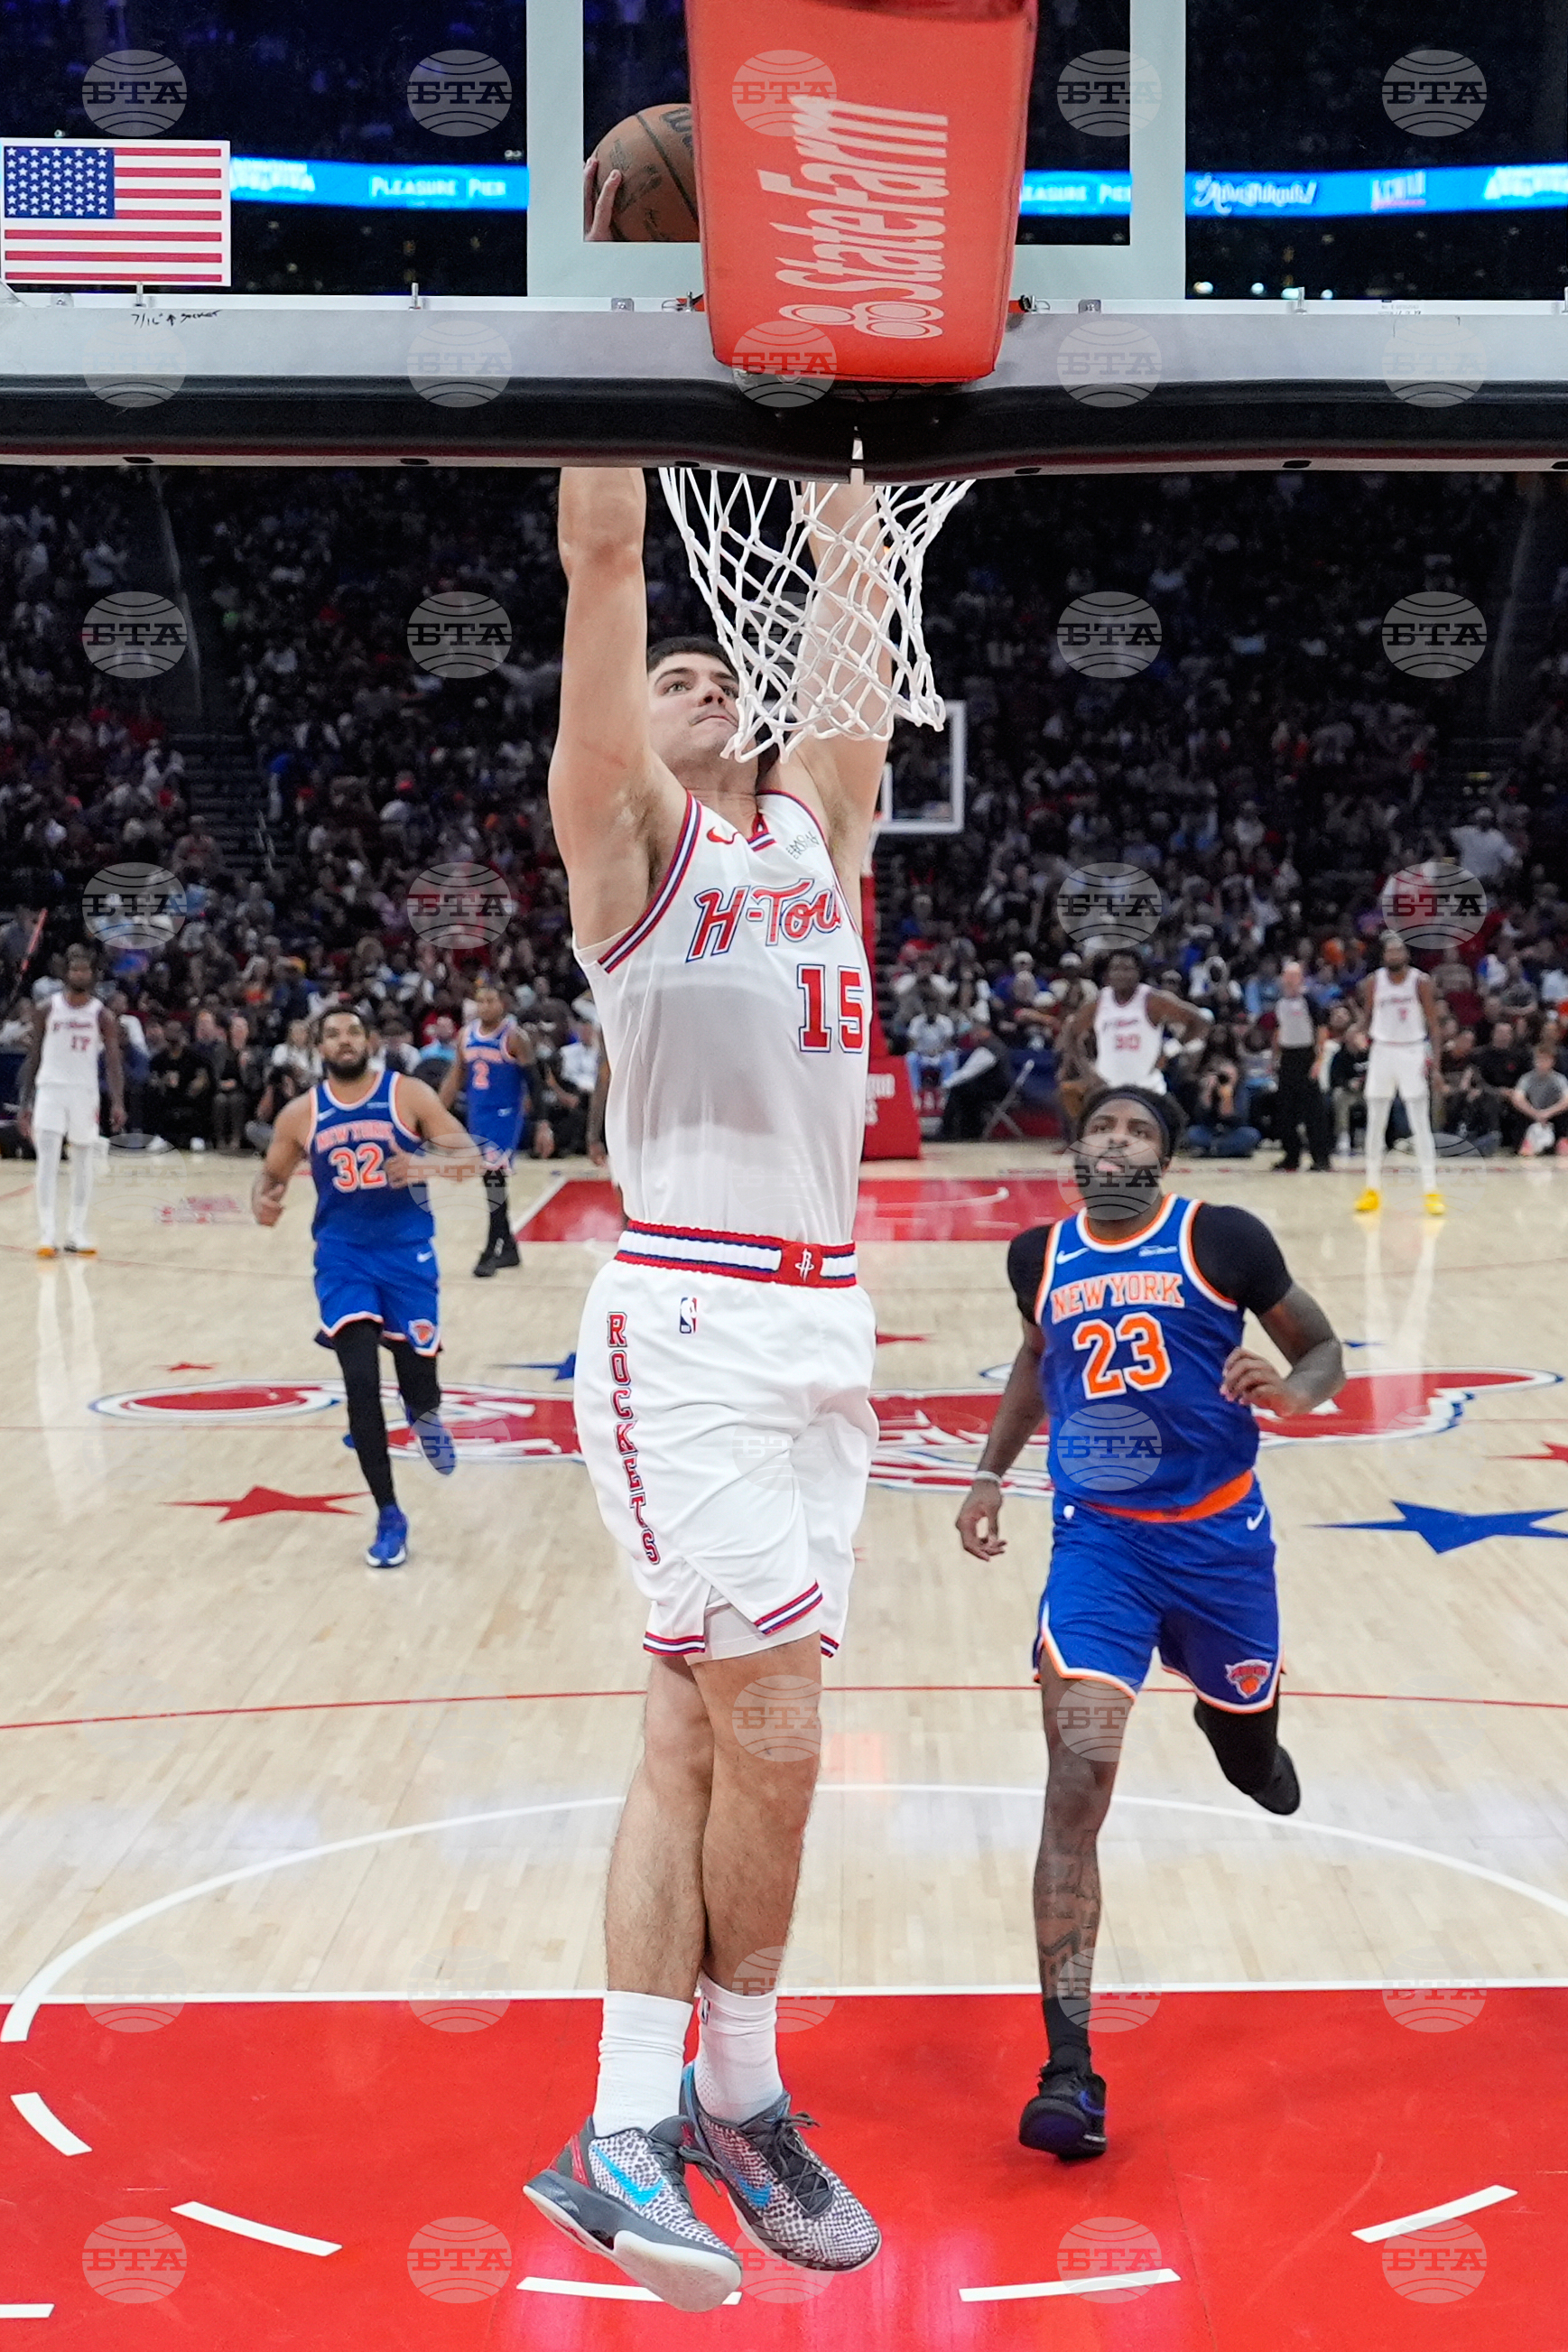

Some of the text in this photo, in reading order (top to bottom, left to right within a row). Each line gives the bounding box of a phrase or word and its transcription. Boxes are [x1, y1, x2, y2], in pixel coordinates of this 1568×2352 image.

[797, 963, 865, 1054] 15
[472, 1059, 490, 1090] 2
[328, 1141, 387, 1193] 32
[1050, 1270, 1185, 1325] NEW YORK
[1072, 1311, 1173, 1400] 23
[607, 1311, 661, 1566] ROCKETS
